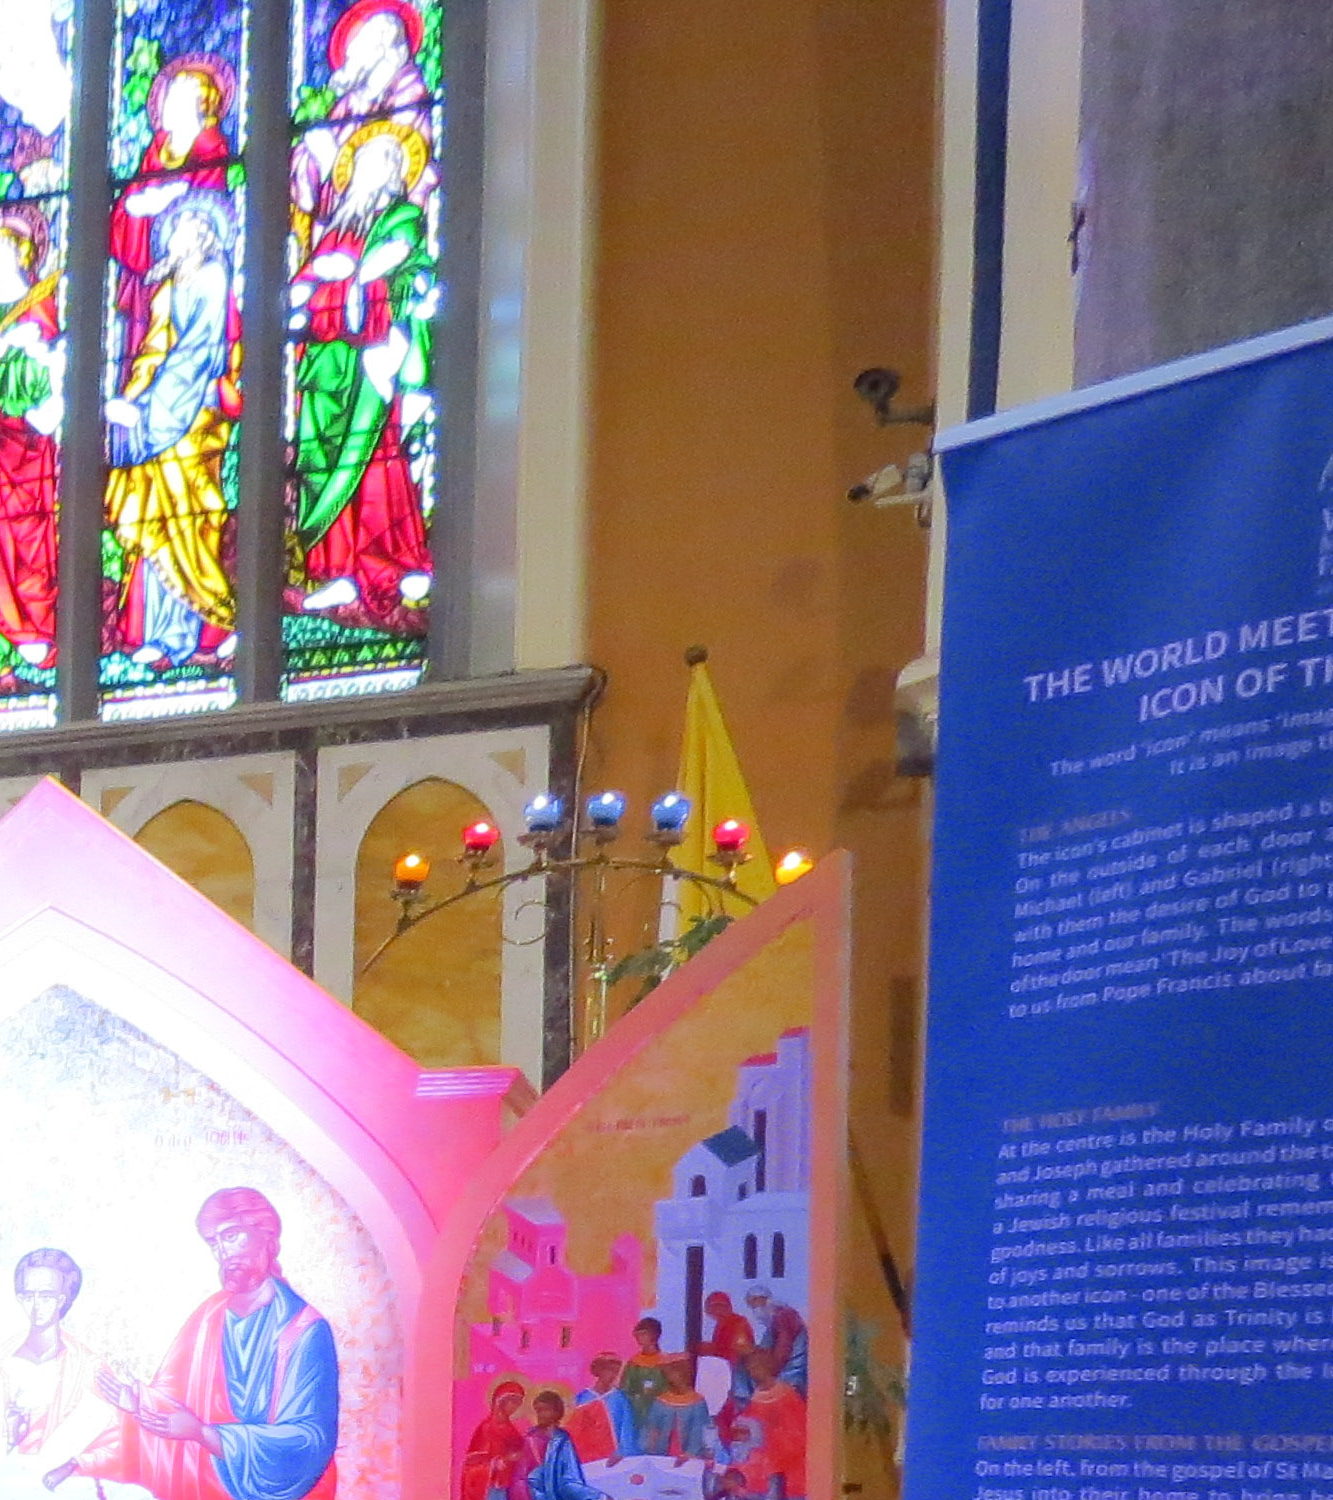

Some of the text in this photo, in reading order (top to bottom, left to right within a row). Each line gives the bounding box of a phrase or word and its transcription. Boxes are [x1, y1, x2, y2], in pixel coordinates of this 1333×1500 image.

[1024, 663, 1093, 702] THE
[1102, 631, 1228, 688] WORLD
[1139, 662, 1288, 722] ICON OF
[999, 1117, 1317, 1159] At the centre is the Holy Family
[996, 1145, 1318, 1184] and Joseph gathered around the
[995, 1190, 1061, 1210] sharing
[1087, 1181, 1134, 1201] meal
[1143, 1178, 1183, 1197] and
[1192, 1173, 1320, 1194] celebrating
[1008, 1212, 1071, 1234] Jewish
[1076, 1207, 1163, 1229] religious
[1170, 1200, 1250, 1221] festival
[988, 1256, 1312, 1286] of joys and sorrows. This image
[988, 1282, 1248, 1310] to another icon one of the
[986, 1309, 1323, 1334] reminds us that God as Trinity is
[984, 1336, 1265, 1360] and that family is the place
[983, 1362, 1313, 1386] God is experienced through the
[976, 1460, 1298, 1481] On the from the gospel of St
